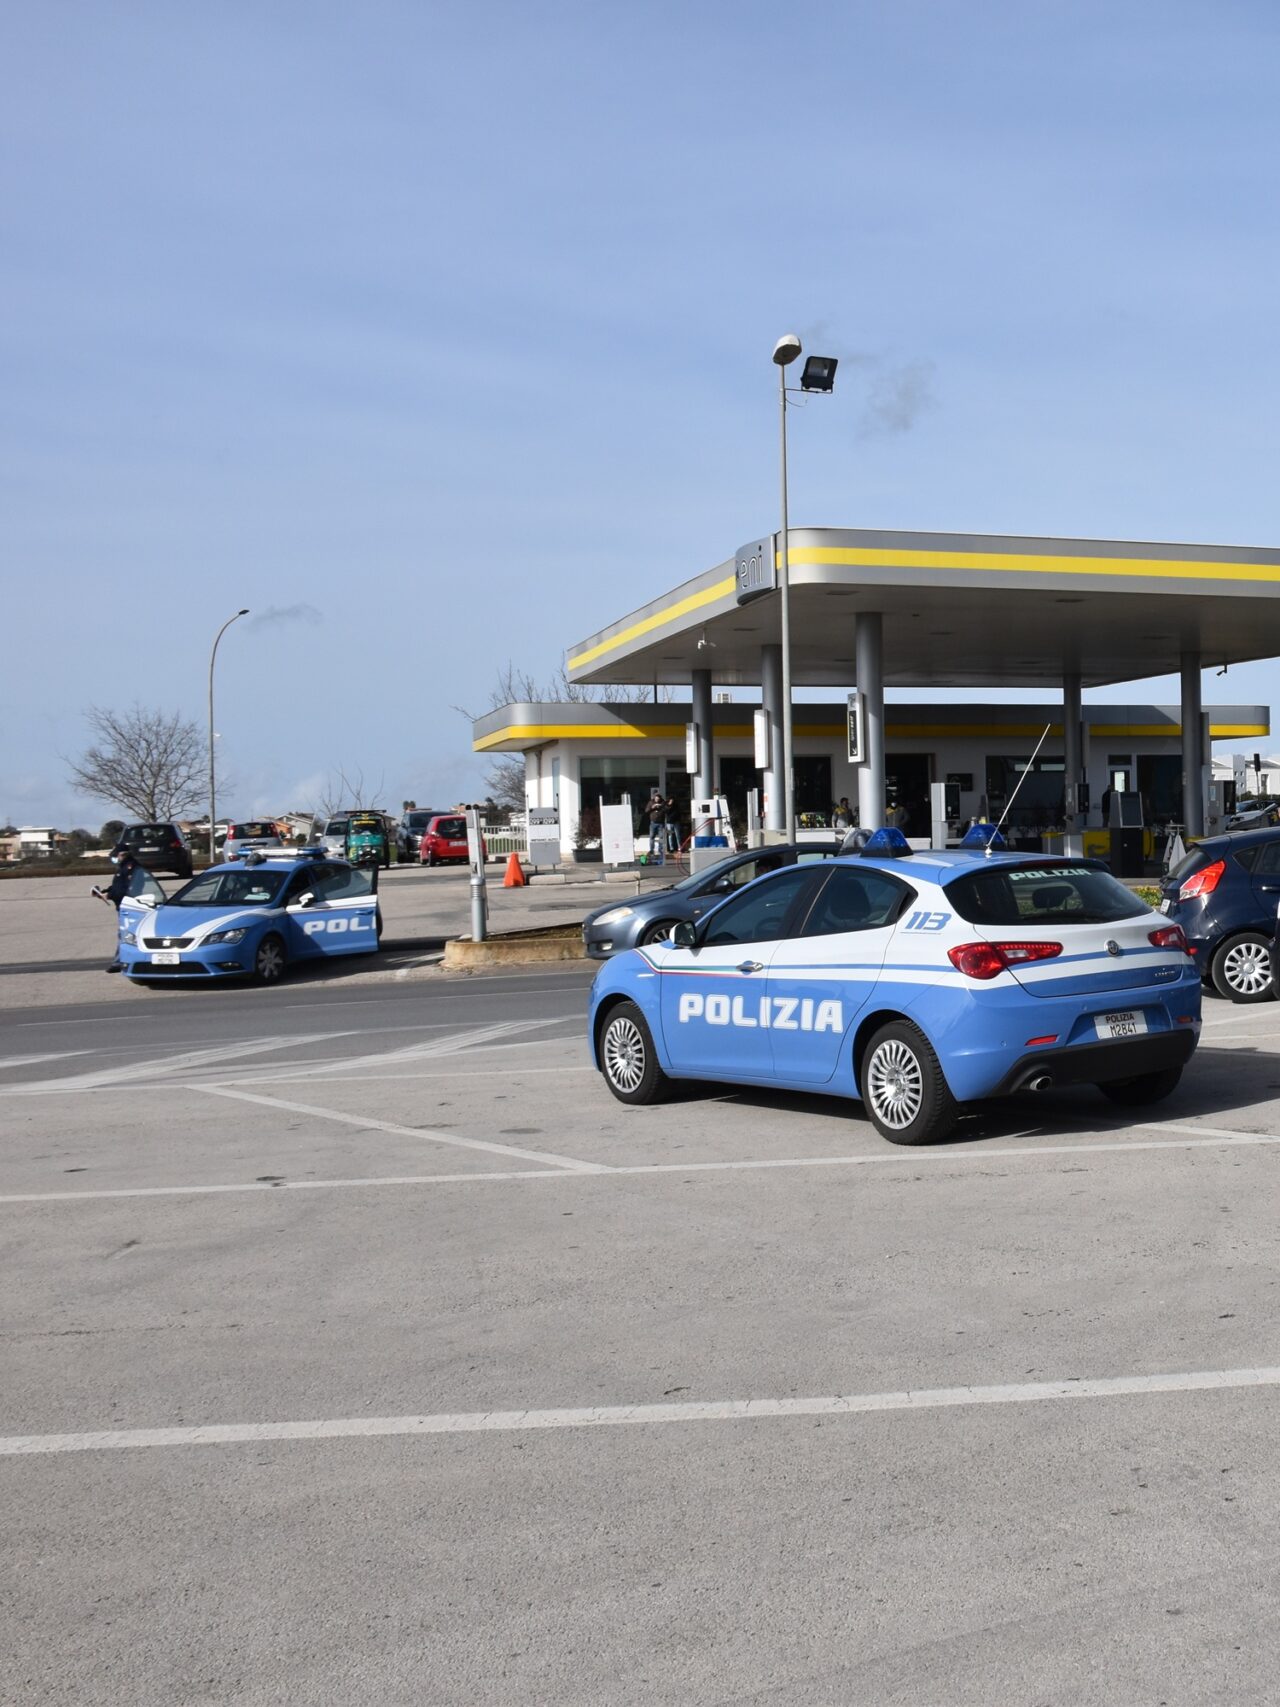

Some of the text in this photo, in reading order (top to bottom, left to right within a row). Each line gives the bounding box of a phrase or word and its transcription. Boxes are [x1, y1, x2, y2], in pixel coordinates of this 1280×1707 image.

[740, 544, 763, 589] eni
[1008, 868, 1092, 881] POLIZIA
[905, 911, 952, 931] 113
[679, 993, 844, 1034] POLIZIA
[1105, 1013, 1135, 1023] POLIZIA
[1110, 1022, 1137, 1036] M2841
